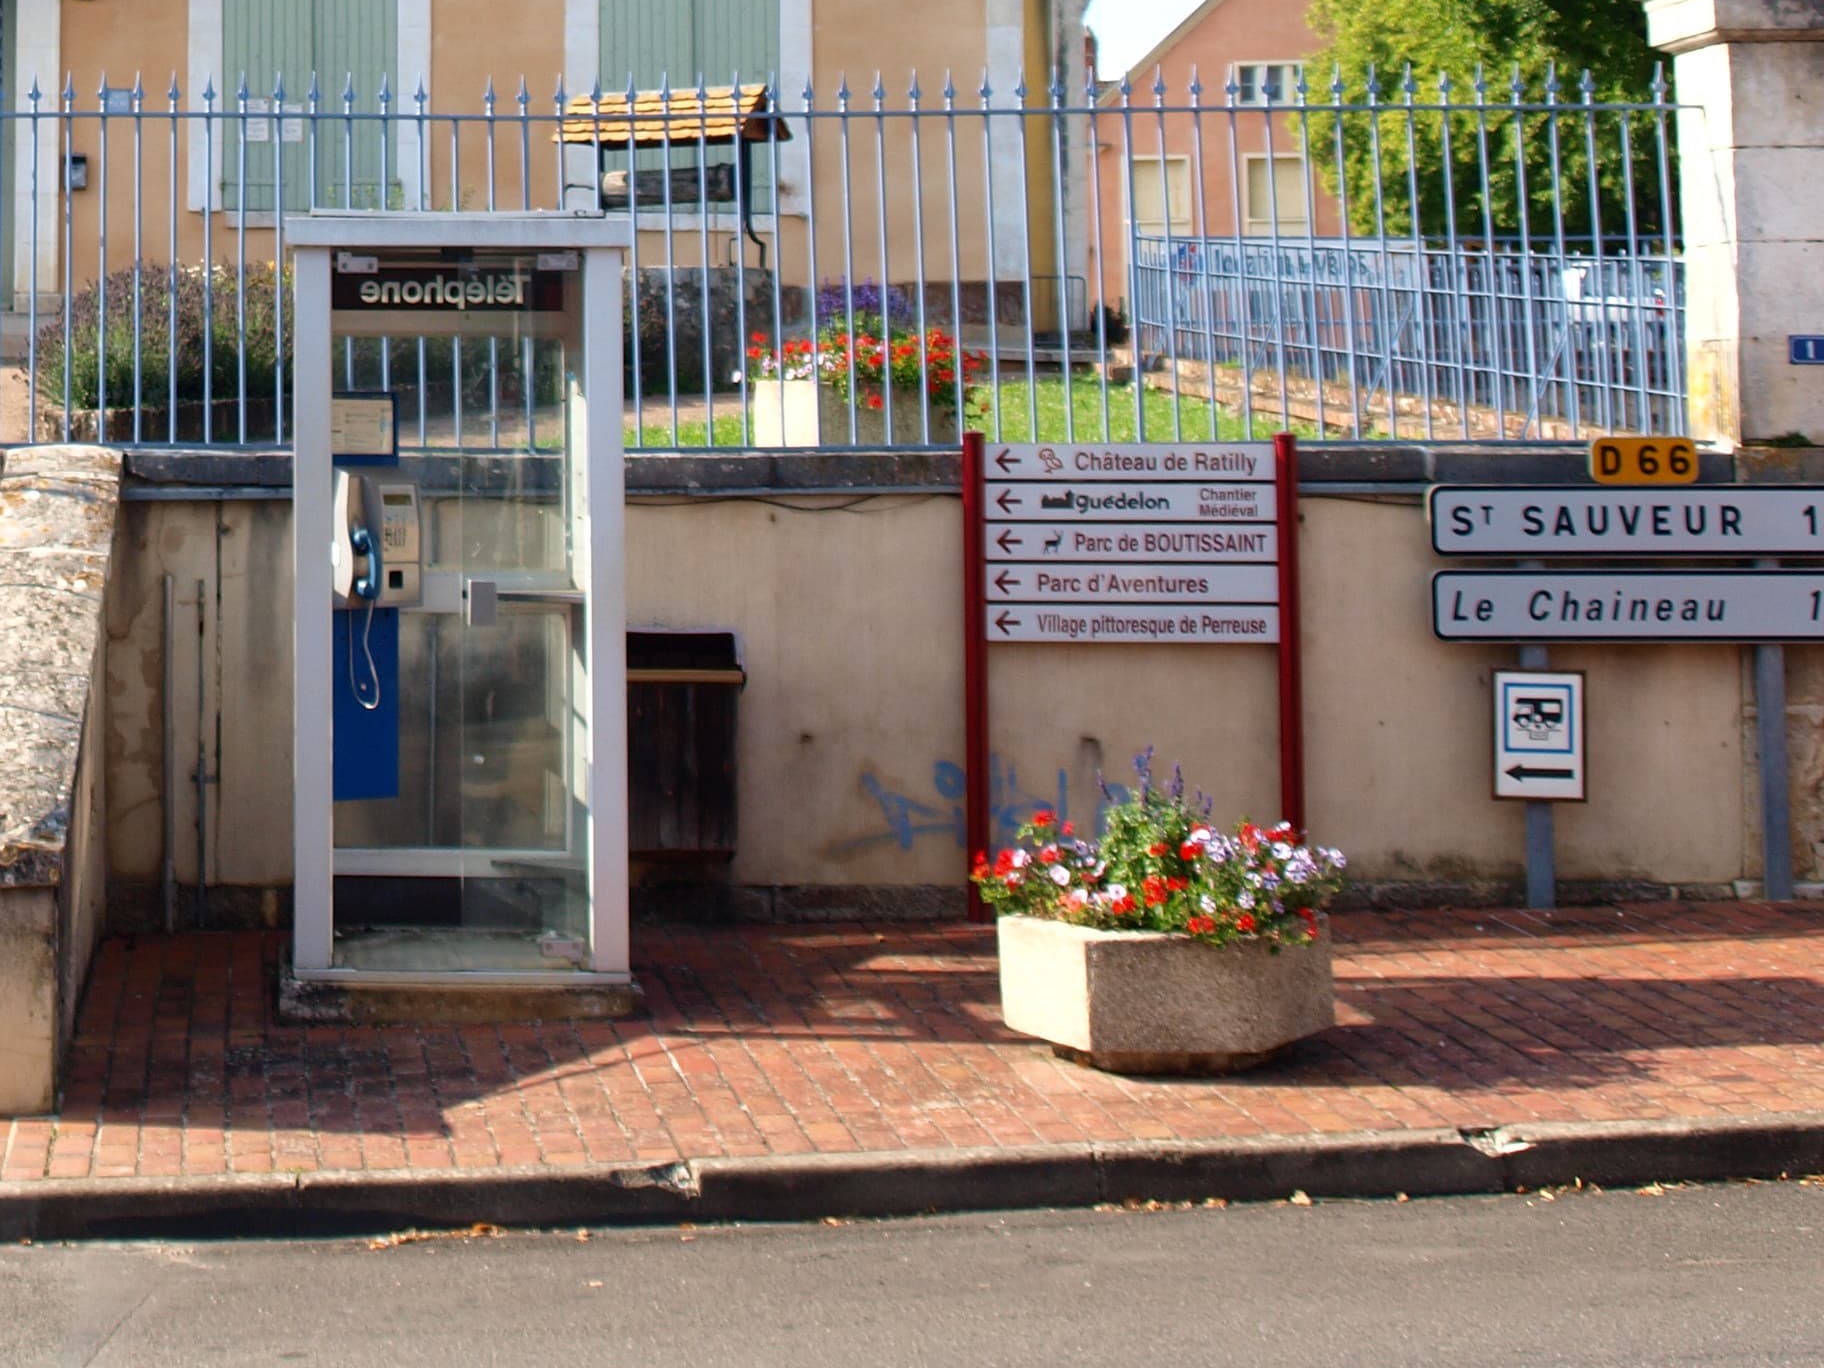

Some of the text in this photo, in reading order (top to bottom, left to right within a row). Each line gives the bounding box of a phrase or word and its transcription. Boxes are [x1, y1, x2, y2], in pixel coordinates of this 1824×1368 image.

[1075, 452, 1258, 476] Château de Ratilly
[1600, 444, 1692, 477] D 66
[1199, 487, 1257, 502] Chantier
[1198, 503, 1259, 518] Médiéval
[1522, 505, 1744, 537] SAUVEUR
[1075, 533, 1267, 553] Parc de BOUTISSAINT
[1037, 573, 1209, 594] Parc d'Aventures
[1452, 590, 1494, 622] Le
[1528, 589, 1727, 622] Chaineau
[1037, 614, 1267, 638] Village pittoresque de Perreuse
